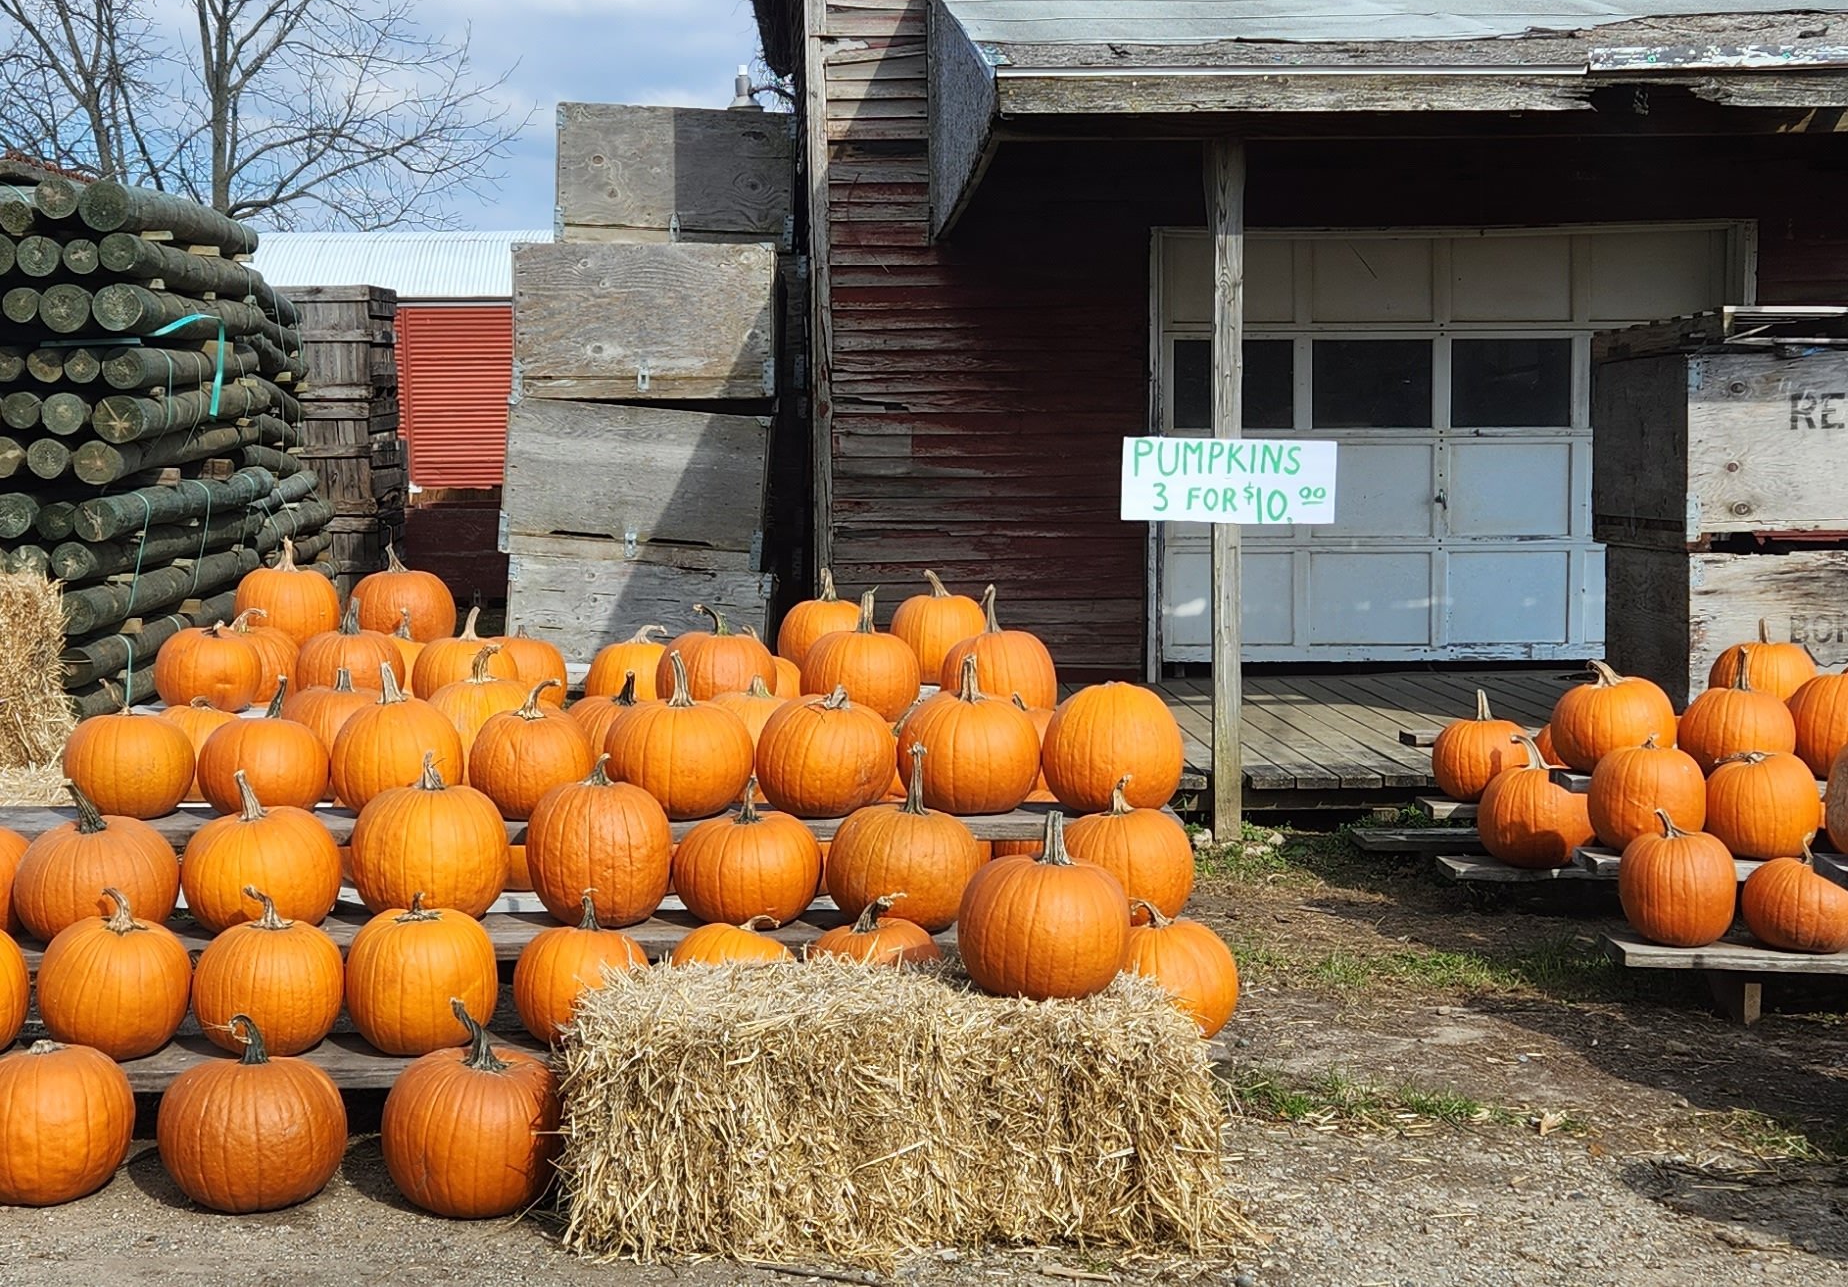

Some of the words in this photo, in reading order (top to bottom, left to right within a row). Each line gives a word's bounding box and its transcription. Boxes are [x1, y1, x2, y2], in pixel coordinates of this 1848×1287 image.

[1133, 439, 1302, 477] PUMPKINS
[1152, 482, 1169, 512] 3
[1186, 487, 1238, 512] FOR
